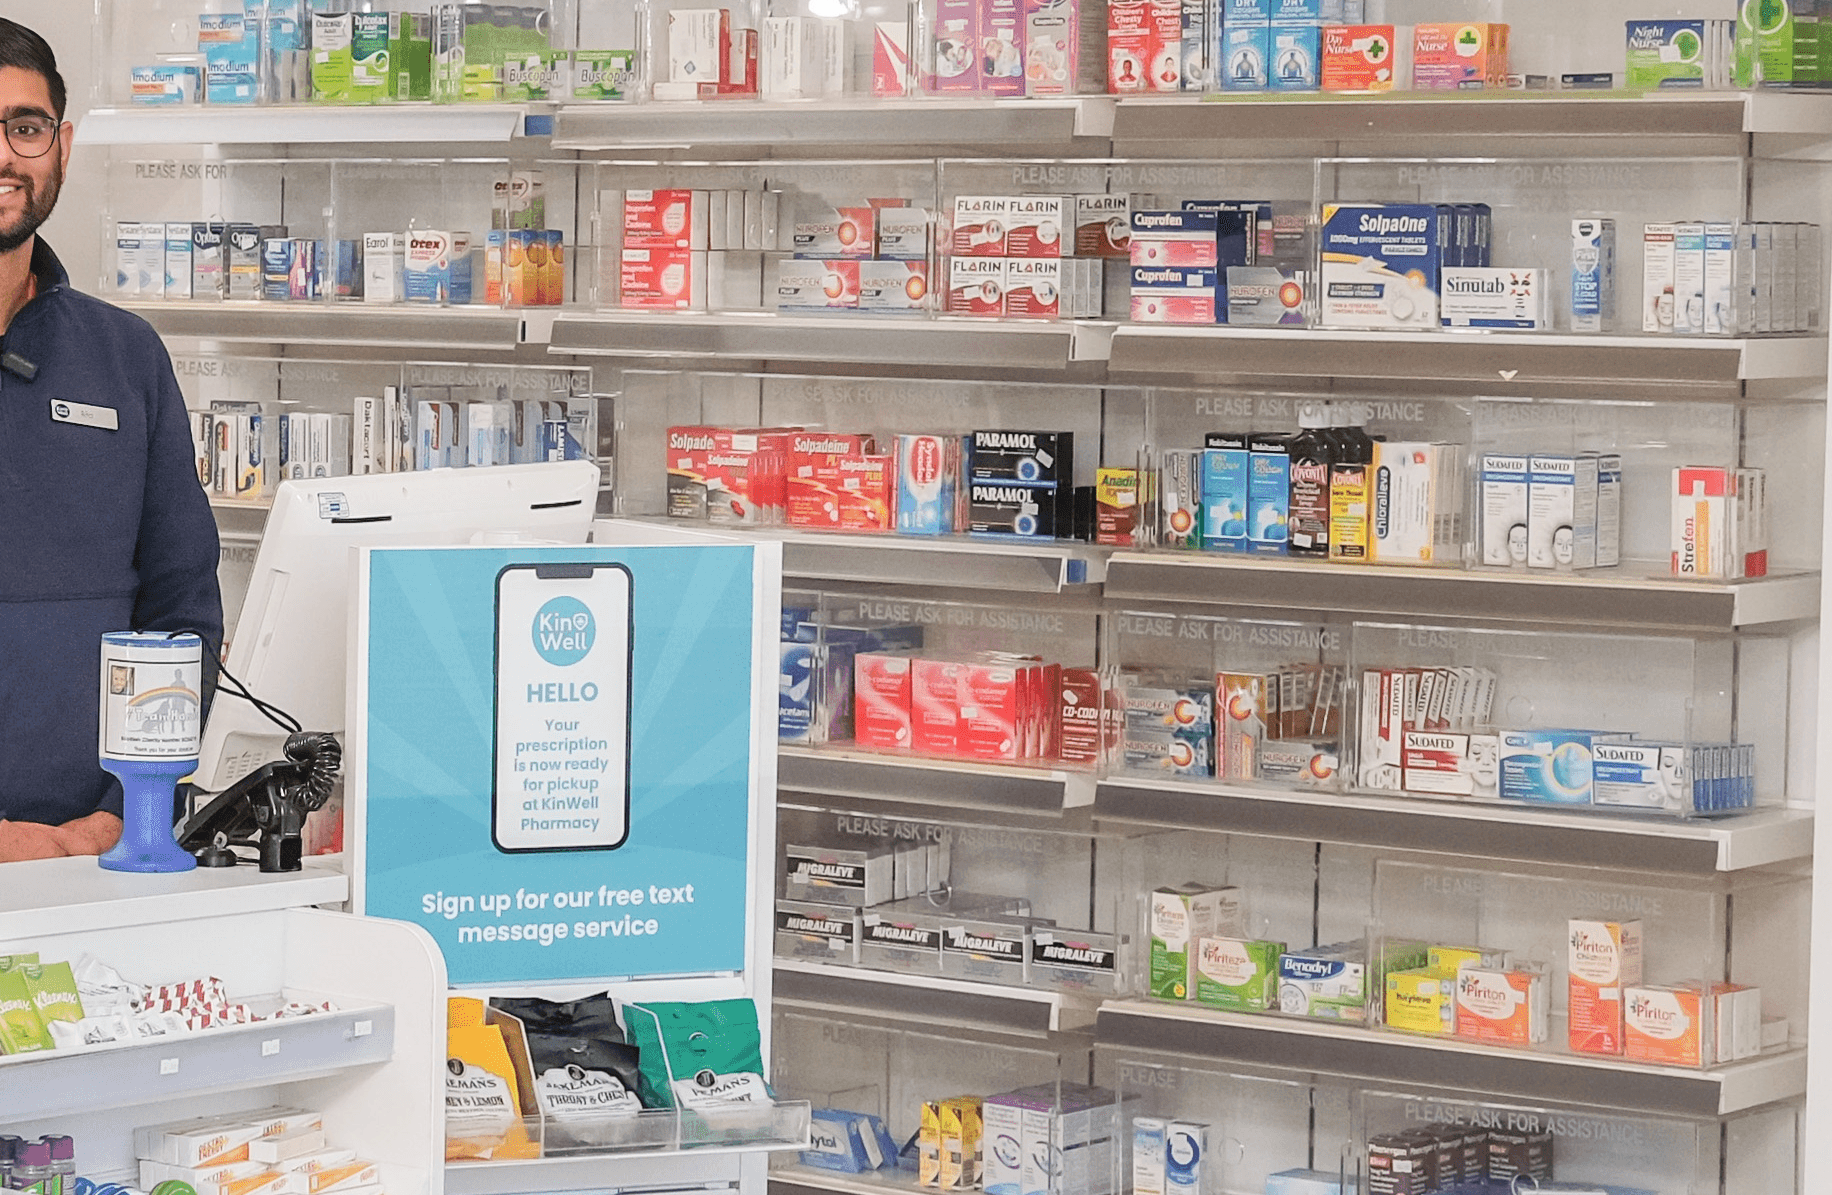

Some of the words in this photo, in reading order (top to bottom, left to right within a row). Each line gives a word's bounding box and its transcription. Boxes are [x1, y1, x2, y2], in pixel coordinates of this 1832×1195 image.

[200, 19, 241, 31] Imodium
[1633, 25, 1665, 40] Night
[1628, 38, 1665, 49] Nurse
[208, 62, 250, 72] Imodium
[509, 68, 559, 83] Buscopan
[132, 71, 174, 83] Imodium
[580, 68, 635, 84] Buscopan
[135, 163, 176, 179] PLEASE
[179, 164, 202, 179] ASK
[958, 200, 1005, 212] FLARIN
[1010, 200, 1059, 212] FLARIN
[1079, 197, 1127, 209] FLARIN
[1134, 212, 1183, 228] Cuprofen
[1358, 214, 1428, 235] SolpaOne
[365, 237, 389, 248] Earol
[953, 261, 1002, 272] FLARIN
[1009, 261, 1057, 273] FLARIN
[1134, 268, 1182, 284] Cuprofen
[1446, 275, 1505, 293] Sinutab
[794, 437, 852, 455] Solpadeine
[975, 432, 1037, 449] PARAMOL
[1486, 458, 1523, 470] SUDAFED
[1532, 459, 1570, 471] SUDAFED
[972, 487, 1034, 504] PARAMOL
[1681, 517, 1695, 573] Strefen
[539, 612, 572, 631] Kin
[1118, 617, 1173, 638] PLEASE
[1179, 620, 1208, 640] ASK
[540, 632, 588, 652] Well
[526, 681, 599, 704] HELLO
[545, 718, 580, 732] Your
[515, 736, 608, 755] prescription
[1408, 733, 1455, 749] SUDAFED
[1596, 747, 1644, 762] SUDAFED
[514, 758, 526, 772] is
[529, 760, 561, 772] now
[564, 757, 609, 774] ready
[522, 777, 544, 791] for
[547, 776, 600, 795] pickup
[522, 798, 538, 811] at
[541, 795, 599, 811] KinWell
[521, 815, 600, 833] Pharmacy
[837, 817, 889, 837] PLEASE
[796, 861, 855, 879] MIGRALEVE
[422, 890, 475, 920] Sign
[480, 893, 512, 917] up
[516, 888, 550, 910] for
[553, 890, 593, 909] our
[597, 884, 644, 906] free
[648, 883, 694, 904] text
[458, 920, 569, 947] message
[573, 913, 658, 938] service
[786, 917, 844, 934] MIGRALEVE
[871, 925, 929, 944] MIGRALEVE
[953, 935, 1013, 954] MIGRALEVE
[1576, 940, 1613, 954] Piriton
[1042, 946, 1104, 964] MIGRALEVE
[1284, 958, 1333, 975] Benadryl
[1466, 984, 1506, 1001] Piriton
